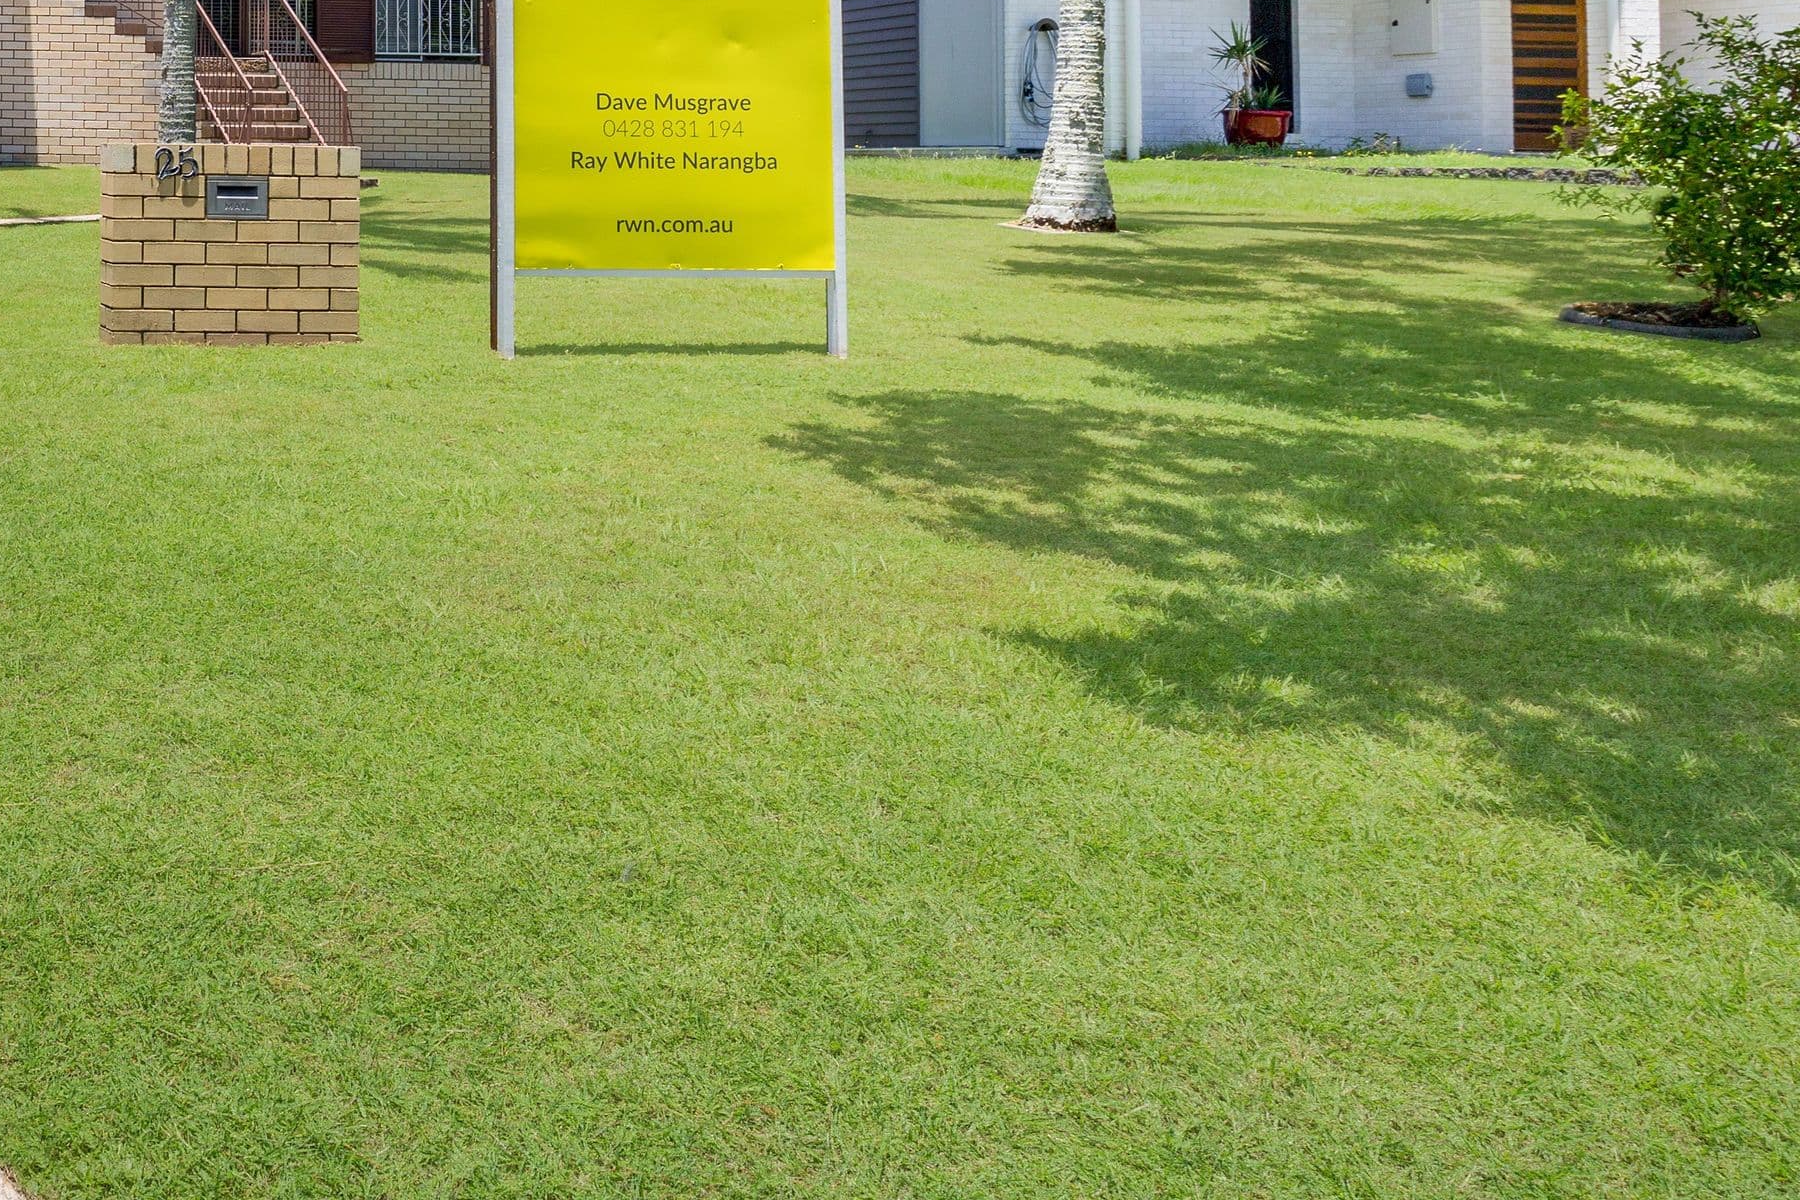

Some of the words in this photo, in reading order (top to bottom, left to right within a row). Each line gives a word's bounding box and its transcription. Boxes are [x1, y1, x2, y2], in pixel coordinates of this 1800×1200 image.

[596, 92, 648, 111] Dave
[654, 93, 751, 115] Musgrave
[602, 119, 655, 138] 0428
[661, 119, 699, 138] 831
[708, 119, 745, 138] 194
[155, 146, 199, 180] 25
[571, 151, 608, 173] Ray
[613, 151, 676, 170] White
[682, 151, 778, 174] Narangba
[616, 219, 733, 234] rwn.com.au
